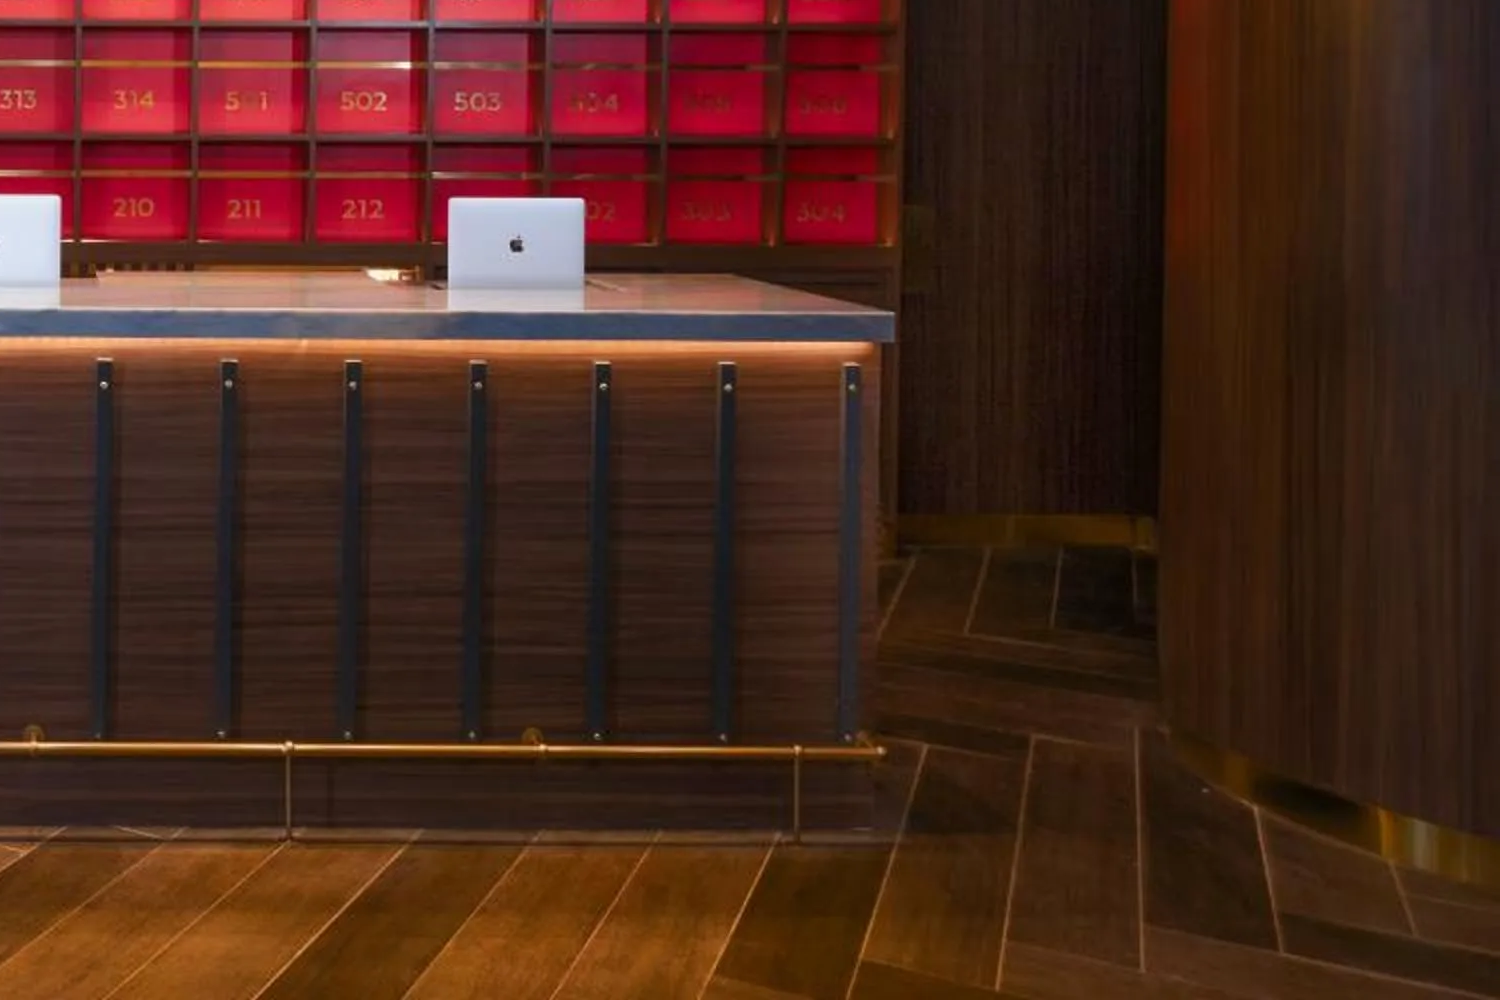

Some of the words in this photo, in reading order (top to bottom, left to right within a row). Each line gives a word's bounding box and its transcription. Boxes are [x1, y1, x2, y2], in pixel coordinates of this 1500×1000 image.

[0, 89, 38, 111] 313
[113, 90, 155, 111] 314
[224, 91, 268, 112] 51
[339, 91, 389, 113] 502
[453, 91, 501, 113] 503
[112, 197, 155, 218] 210
[227, 198, 262, 219] 211
[340, 198, 384, 220] 212
